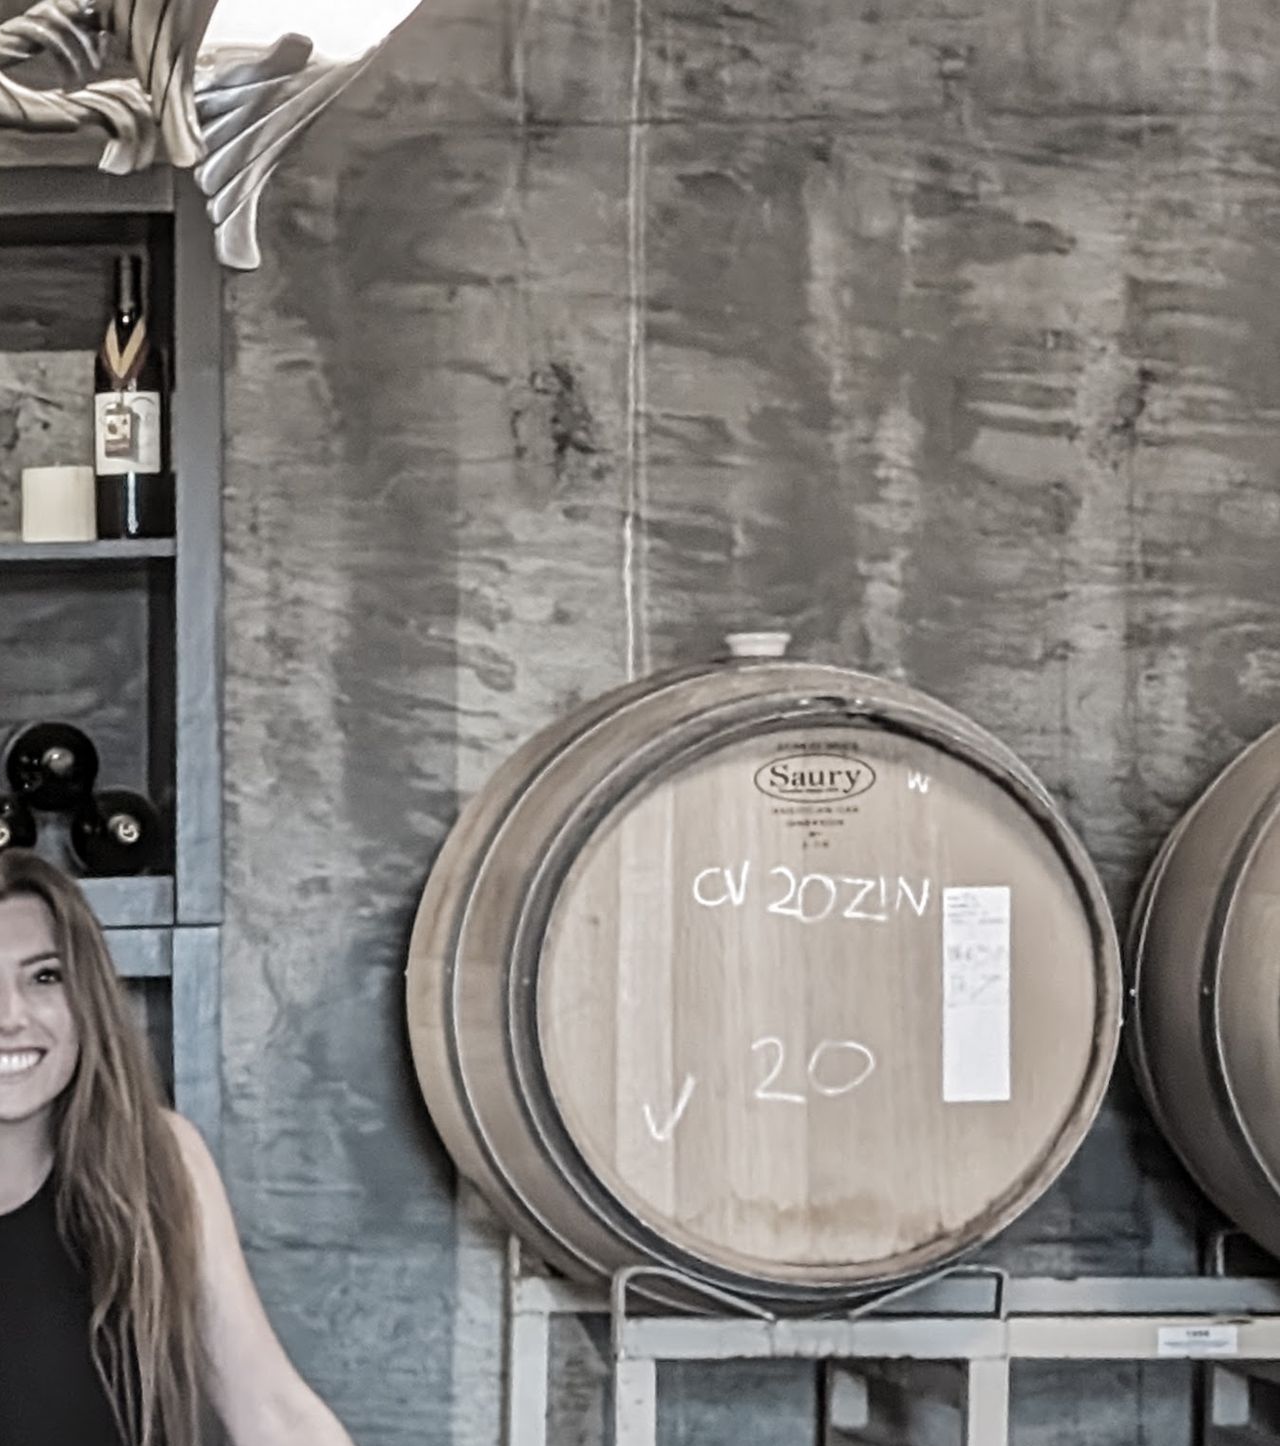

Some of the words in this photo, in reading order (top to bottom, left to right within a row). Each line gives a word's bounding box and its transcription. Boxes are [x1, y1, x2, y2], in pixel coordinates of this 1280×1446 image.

[770, 764, 861, 794] Saury
[693, 861, 750, 907] CV
[751, 1037, 876, 1103] 20
